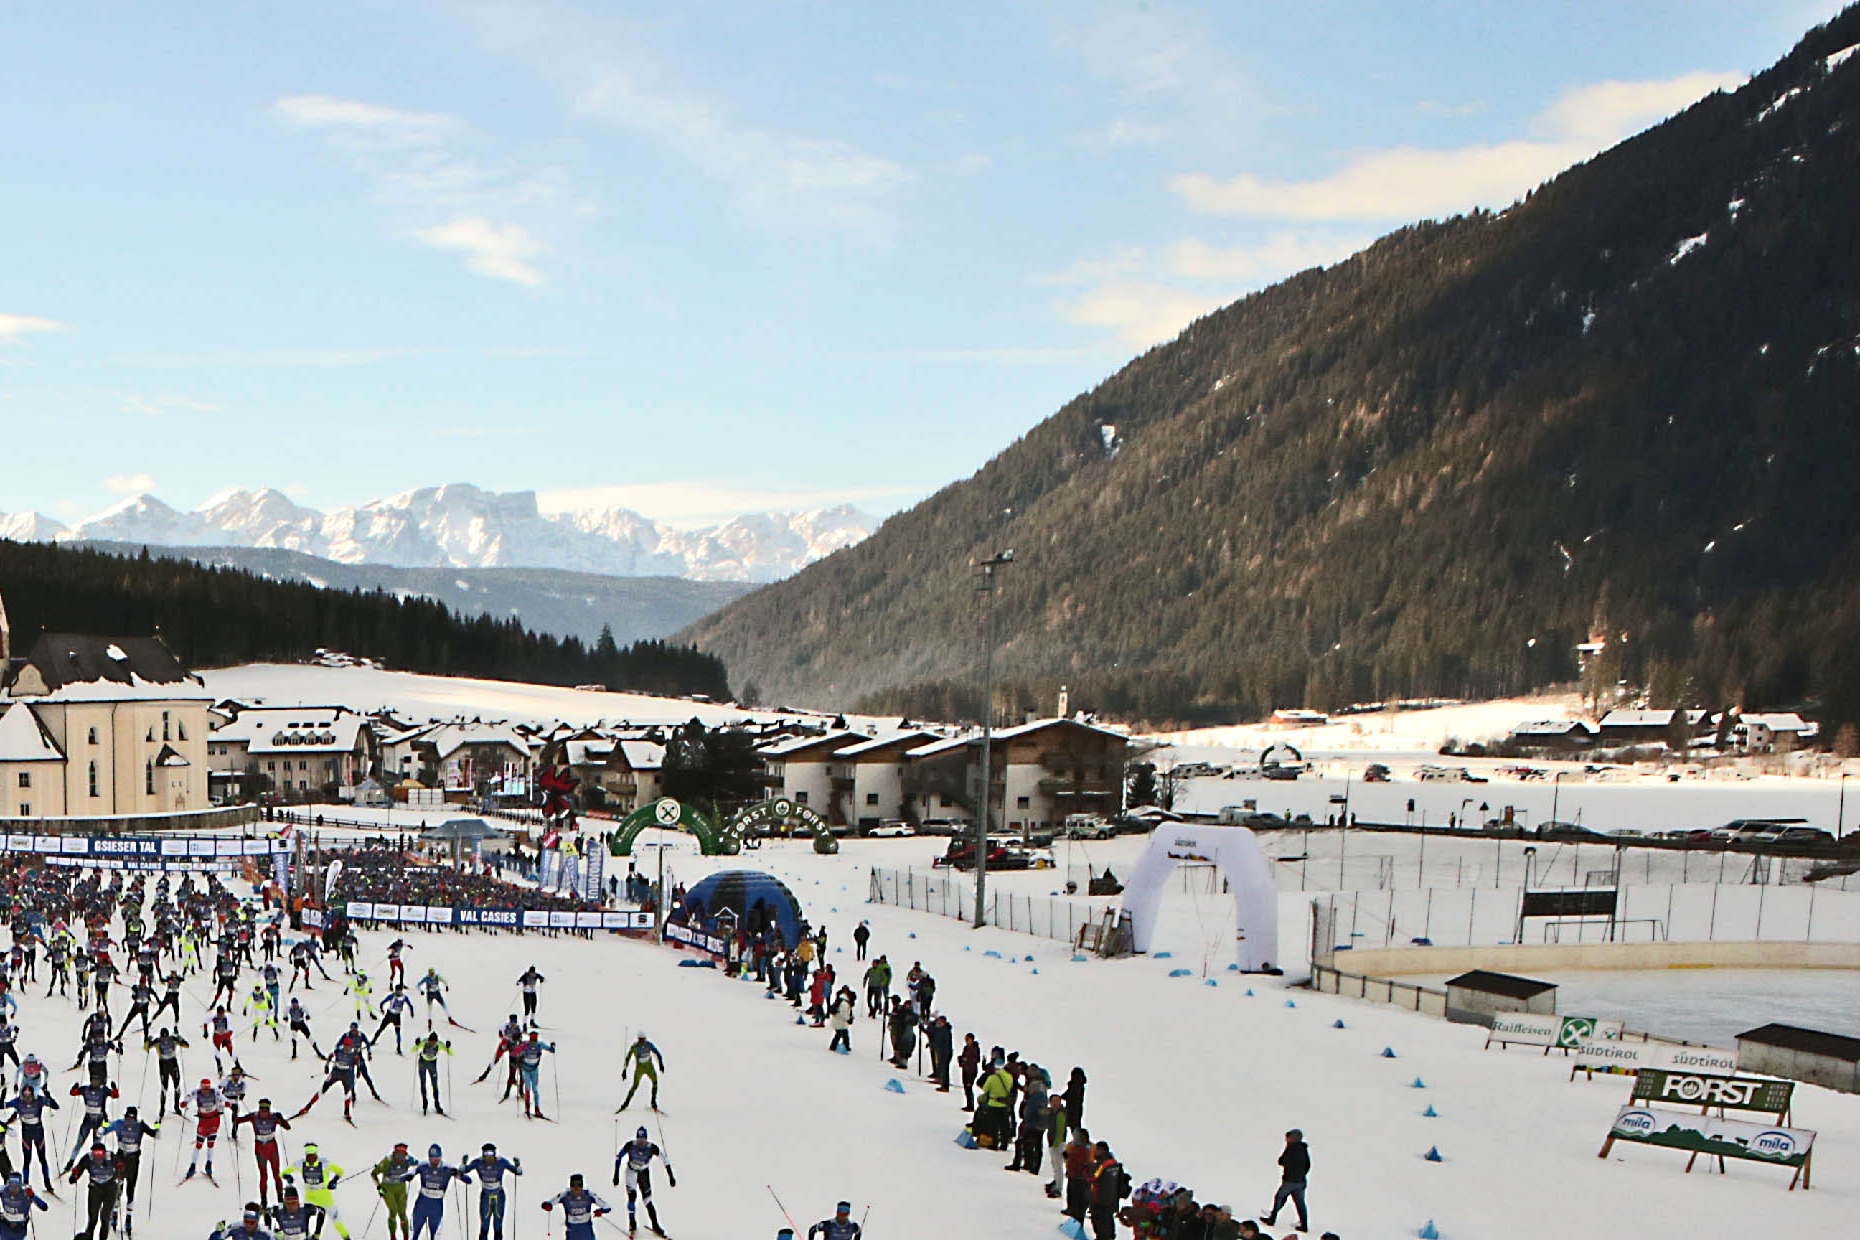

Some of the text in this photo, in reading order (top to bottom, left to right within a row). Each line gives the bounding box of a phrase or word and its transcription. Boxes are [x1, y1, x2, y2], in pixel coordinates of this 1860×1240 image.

[731, 807, 767, 839] FORST
[796, 806, 829, 836] FORST
[94, 840, 137, 852] GSIESER
[139, 841, 157, 853] TAL
[460, 910, 478, 922] VAL
[481, 910, 517, 924] CASIES
[1662, 1074, 1762, 1105] FORST
[1622, 1116, 1651, 1130] mila
[1759, 1136, 1790, 1151] mila
